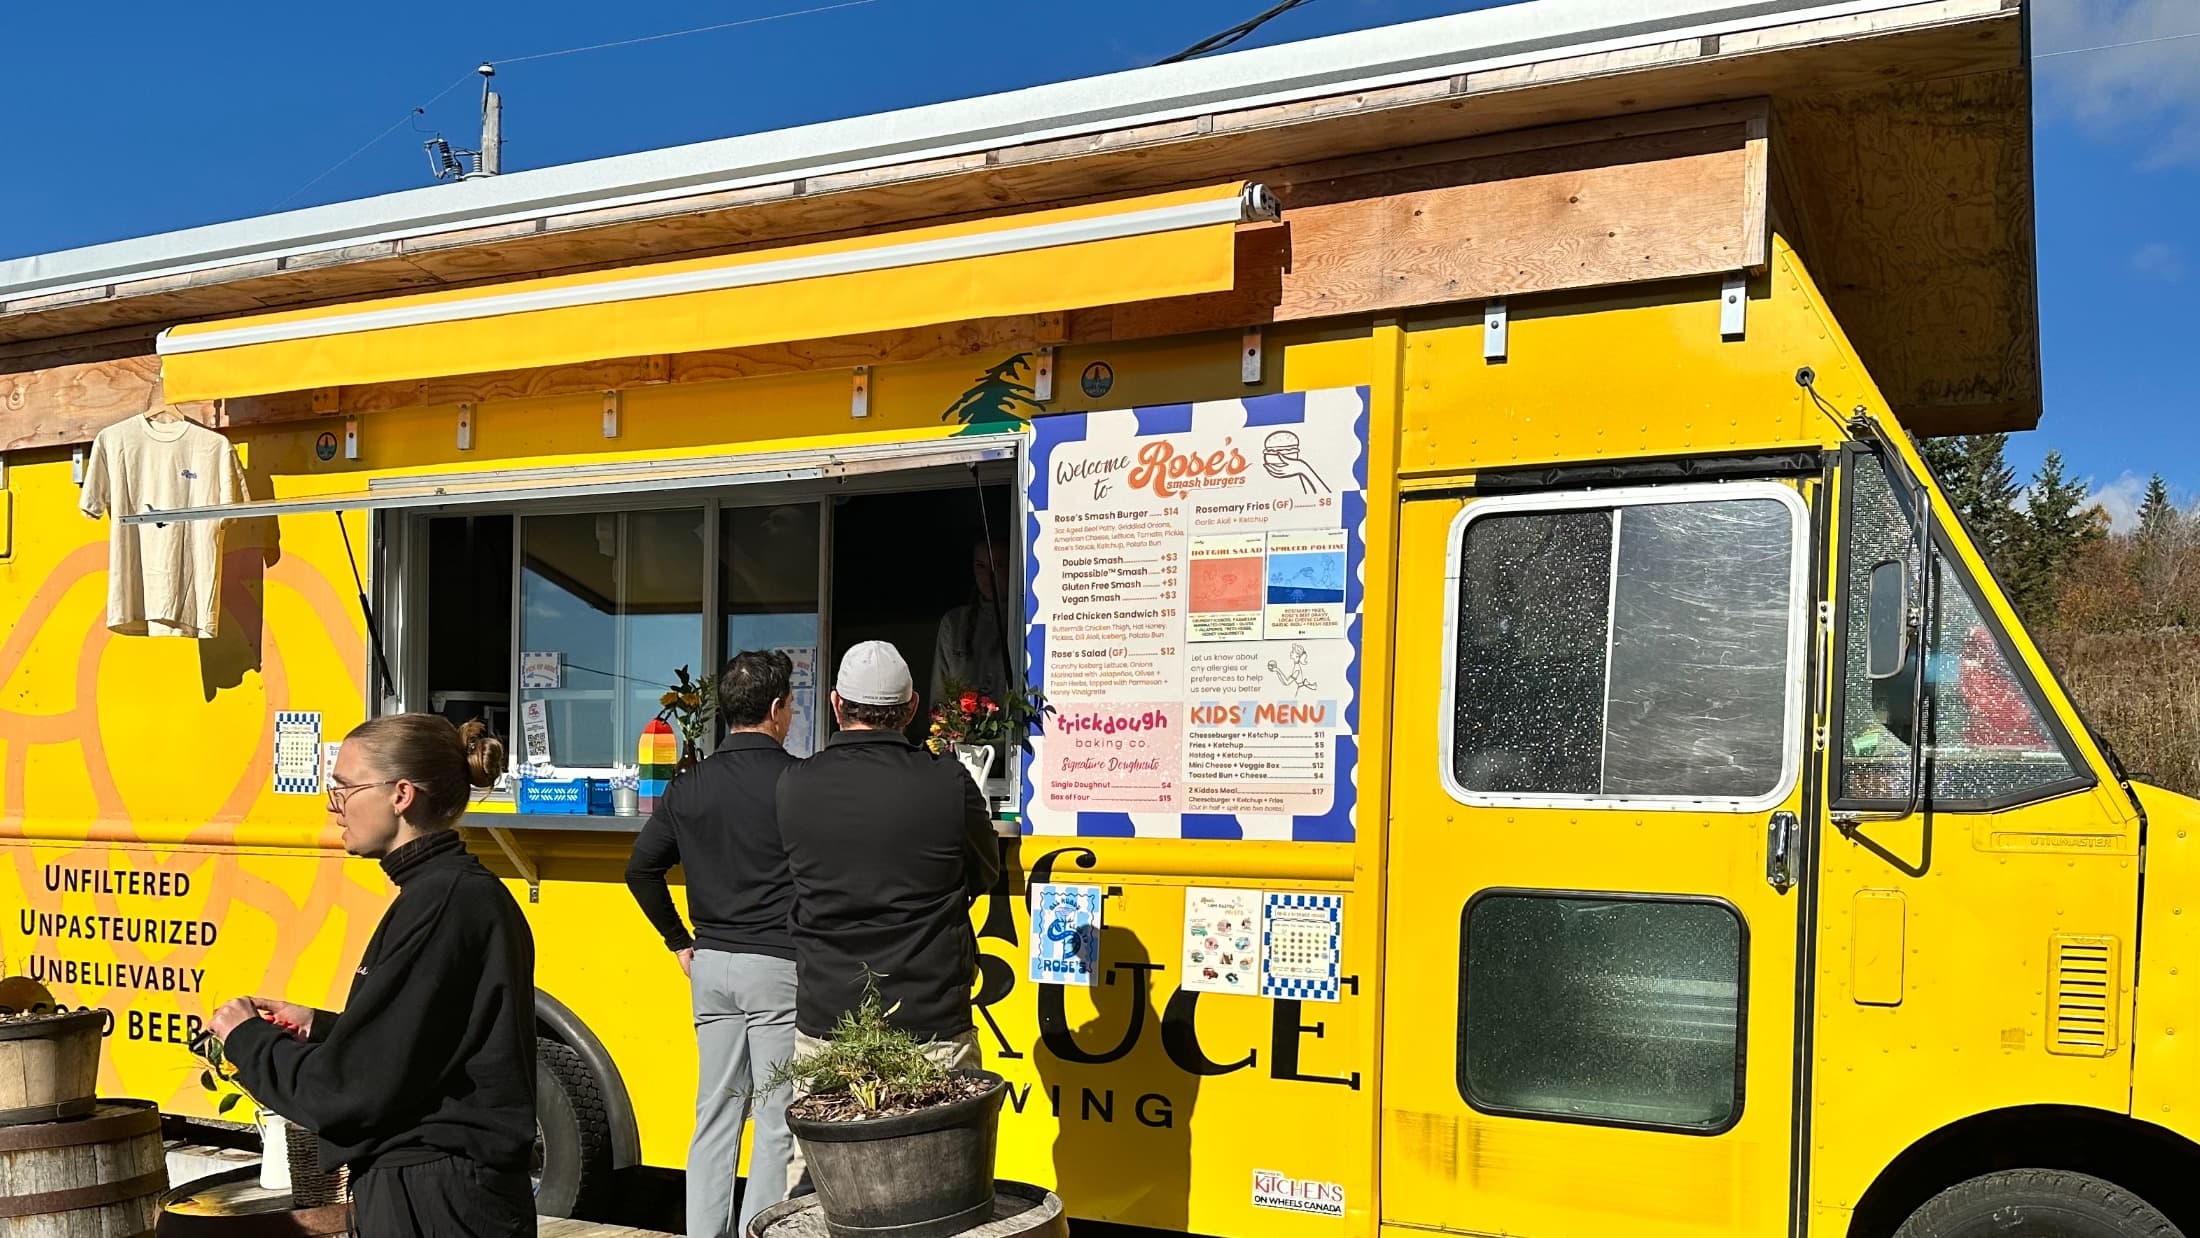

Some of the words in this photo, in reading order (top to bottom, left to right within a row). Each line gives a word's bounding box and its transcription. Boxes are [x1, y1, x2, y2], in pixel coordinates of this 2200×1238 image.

[1057, 455, 1130, 485] Welcome
[1127, 436, 1251, 499] Rose's
[1166, 475, 1200, 489] smash
[1203, 474, 1245, 489] burgers
[1094, 478, 1111, 500] to
[1195, 503, 1244, 514] Rosemary
[1246, 502, 1270, 511] Fries
[1272, 498, 1294, 511] (GF)
[1319, 498, 1332, 507] $8
[1054, 514, 1083, 523] Rose's
[1084, 512, 1116, 521] Smash
[1117, 510, 1148, 520] Burger
[1163, 507, 1179, 516] $14
[1239, 515, 1269, 525] Ketchup
[1062, 558, 1092, 567] Double
[1093, 556, 1124, 565] Smash
[1161, 553, 1178, 561] +$3
[1117, 567, 1148, 576] Smash
[1161, 566, 1178, 574] +$2
[1062, 583, 1090, 591] Gluten
[1091, 581, 1109, 590] Free
[1111, 580, 1142, 589] Smash
[1162, 578, 1177, 587] +$1
[1062, 595, 1090, 605] Vegan
[1091, 593, 1121, 602] Smash
[1160, 591, 1177, 599] +$3
[1052, 612, 1074, 621] Fried
[1076, 610, 1112, 620] Chicken
[1113, 609, 1159, 619] Sandwich
[1161, 608, 1176, 617] $15
[1052, 649, 1079, 658] Rose's
[1081, 648, 1107, 657] Salad
[1108, 646, 1128, 658] (GF)
[1160, 647, 1175, 656] $12
[1214, 653, 1233, 661] know
[1206, 664, 1238, 673] allergies
[1190, 675, 1235, 683] preferences
[1246, 673, 1263, 682] help
[1222, 686, 1236, 694] you
[1238, 684, 1261, 692] better
[1190, 704, 1247, 725] KIDS'
[1254, 703, 1326, 725] MENU
[1057, 709, 1168, 735] trickdough
[1247, 731, 1279, 739] Ketchup
[1075, 739, 1123, 750] baking
[1129, 740, 1150, 748] co.
[1061, 757, 1106, 772] Signature
[1107, 757, 1160, 773] Doughnuts
[1239, 762, 1265, 770] Veggie
[1188, 771, 1217, 779] Toasted
[1219, 771, 1233, 779] Bun
[1240, 771, 1268, 779] Cheese
[1050, 781, 1073, 790] Single
[1074, 781, 1111, 790] Doughnut
[1050, 793, 1063, 801] Box
[1064, 793, 1072, 801] of
[1073, 793, 1089, 801] Four
[1236, 797, 1263, 805] Ketchup
[45, 864, 190, 897] UNFILTERED
[20, 908, 218, 946] UNPASTEURIZED
[1043, 959, 1087, 974] ROSE'S
[30, 954, 205, 993] UNBELIEVABLY
[1254, 1195, 1268, 1204] ON
[1268, 1196, 1303, 1208] WHEELS
[1303, 1201, 1342, 1213] CANADA
